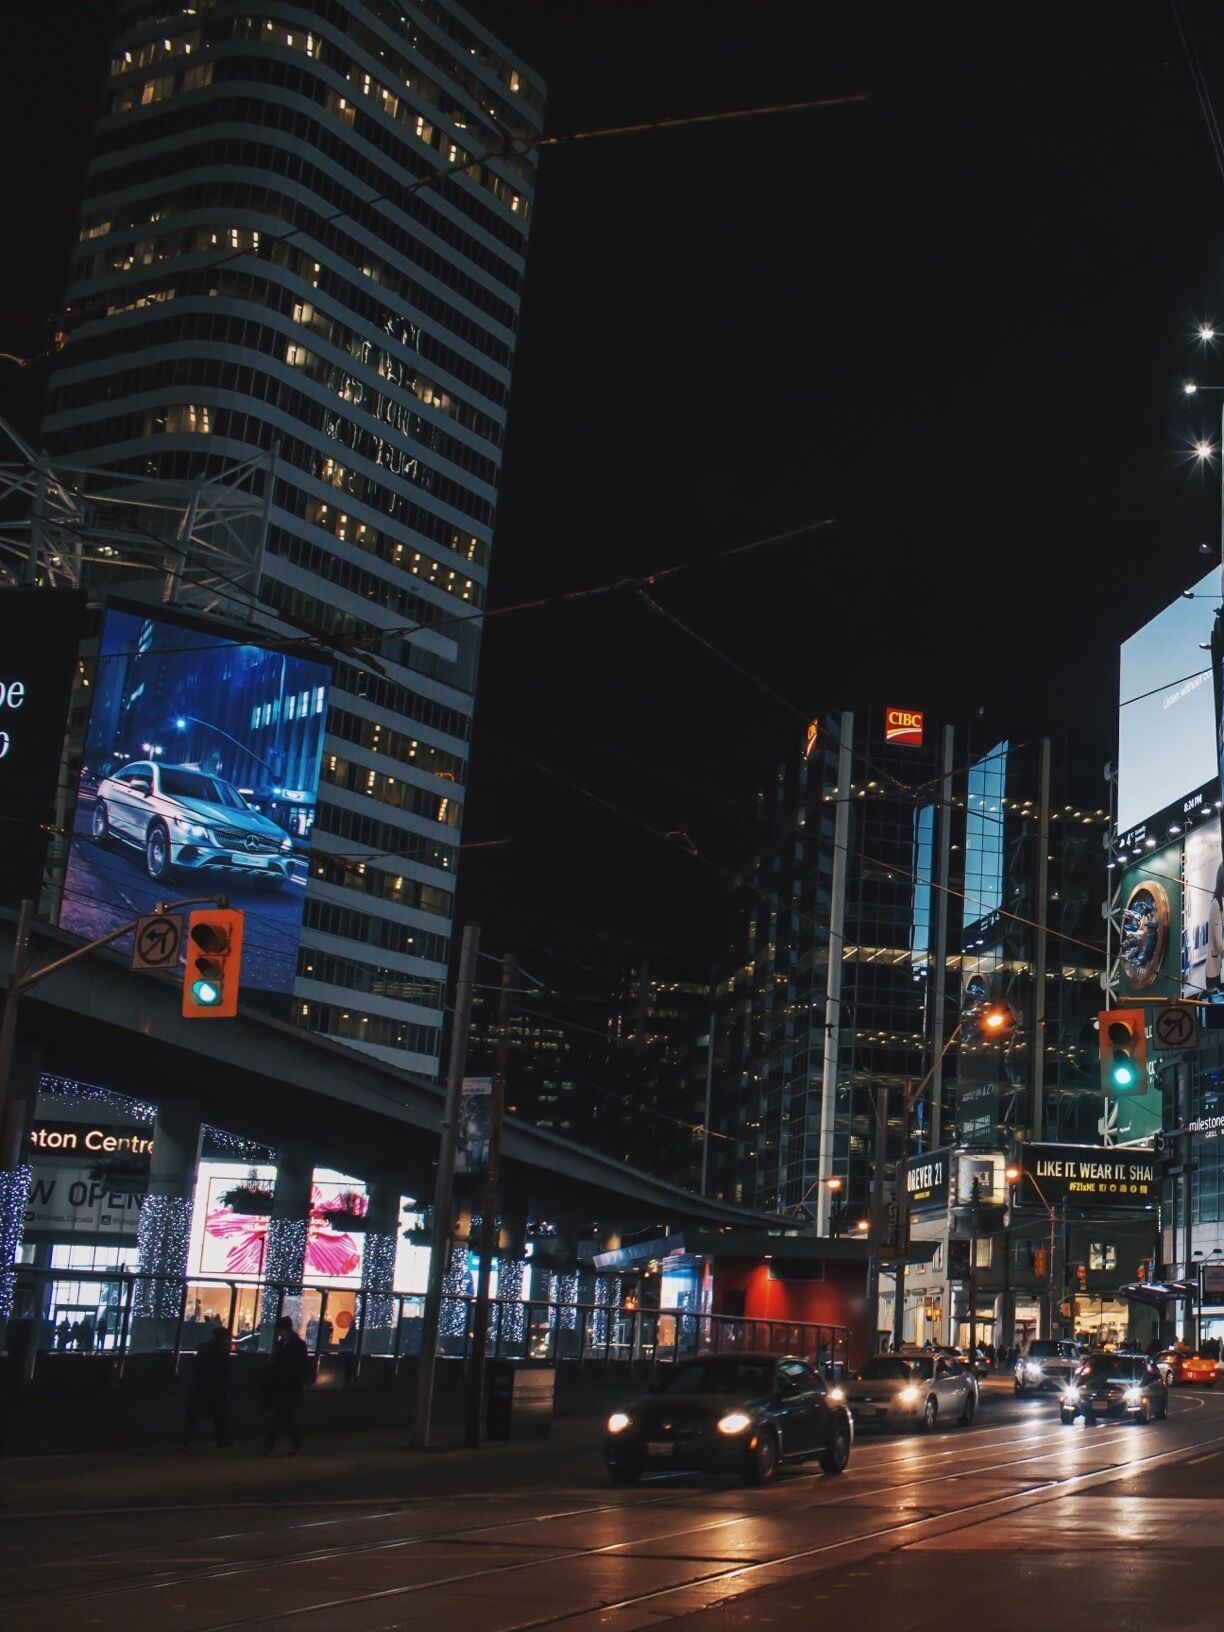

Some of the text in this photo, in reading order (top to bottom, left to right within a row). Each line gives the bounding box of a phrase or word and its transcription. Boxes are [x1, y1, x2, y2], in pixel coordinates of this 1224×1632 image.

[888, 711, 922, 728] CIBC
[934, 1161, 943, 1186] 21
[1036, 1159, 1062, 1178] LIKE
[1064, 1162, 1077, 1178] IT.
[1079, 1163, 1111, 1180] WEAR
[1114, 1164, 1127, 1181] IT.
